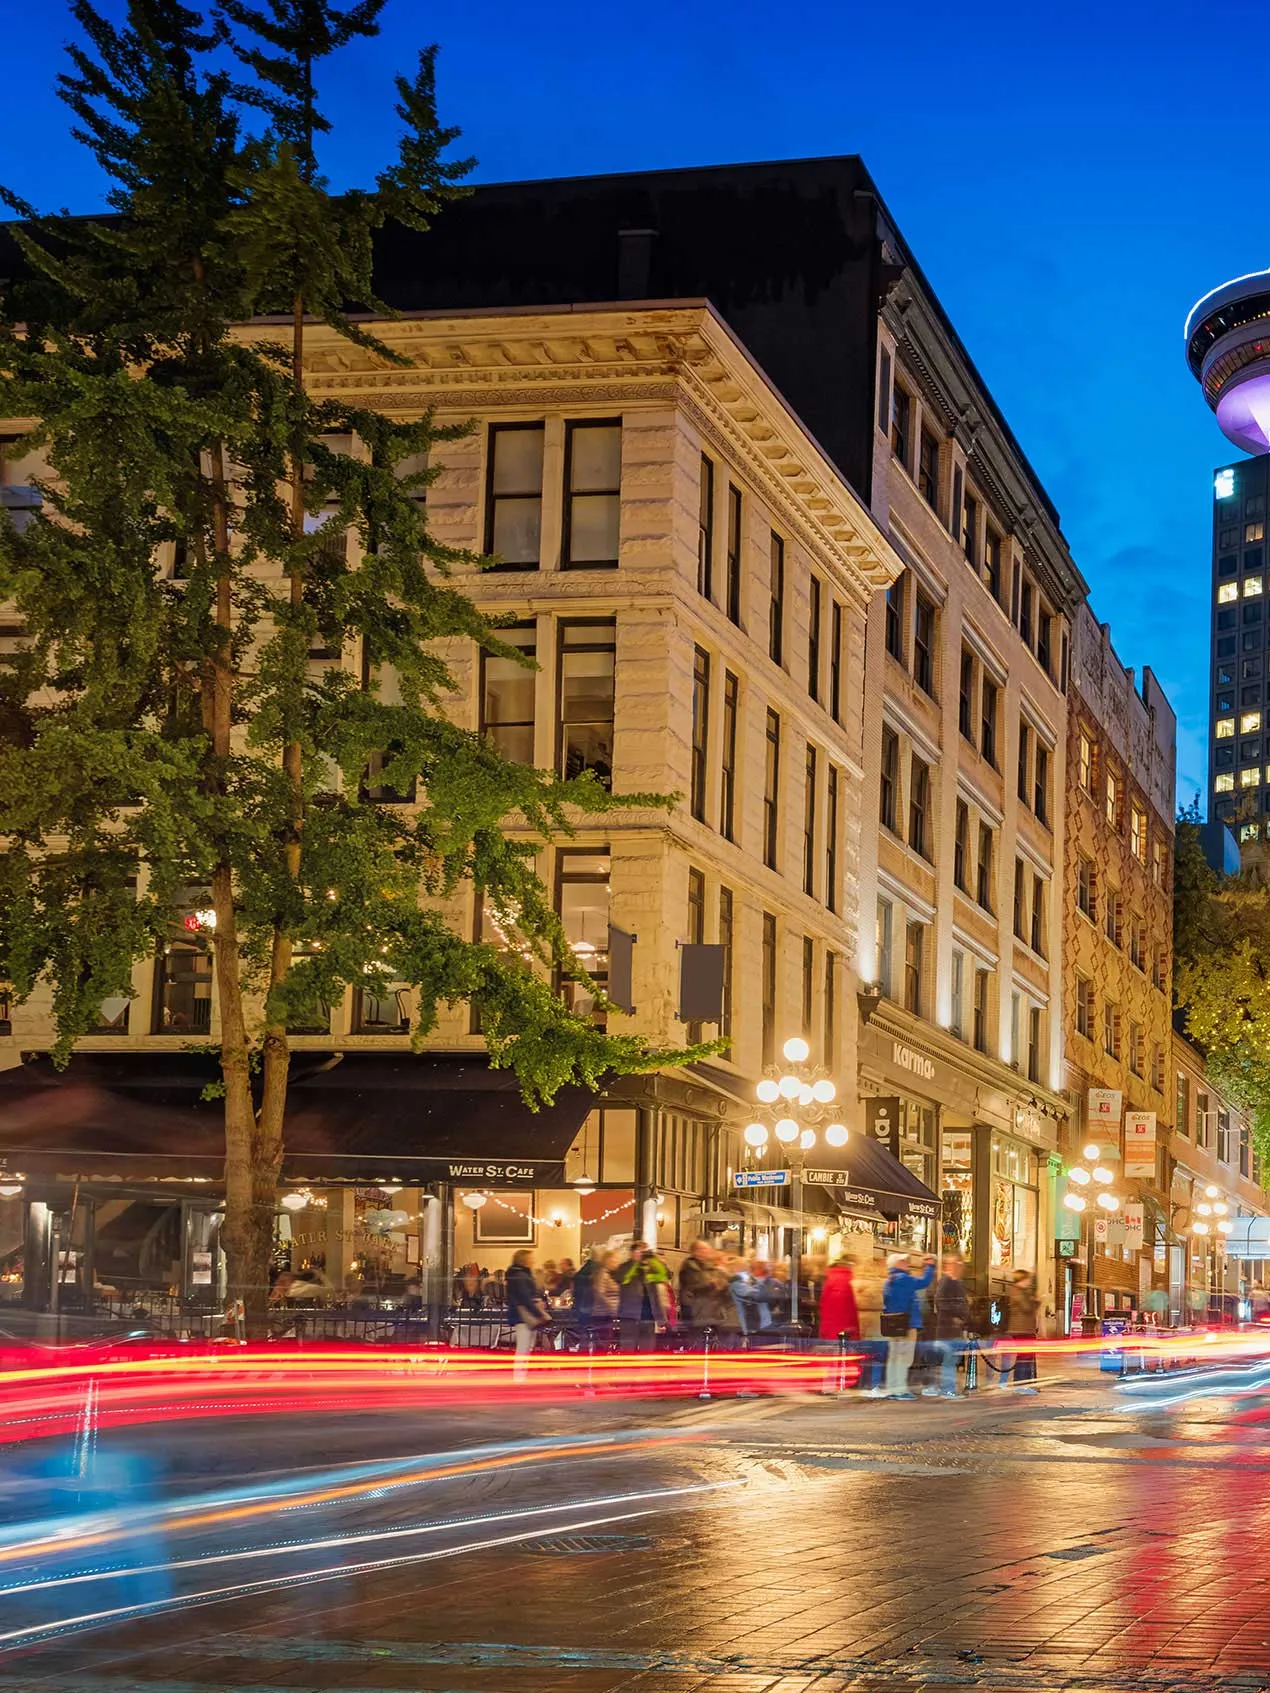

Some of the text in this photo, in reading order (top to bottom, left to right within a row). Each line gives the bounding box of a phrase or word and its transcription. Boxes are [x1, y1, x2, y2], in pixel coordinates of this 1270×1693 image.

[449, 1165, 484, 1177] WATER
[505, 1166, 534, 1178] CAFE
[809, 1172, 834, 1183] CAMBIE
